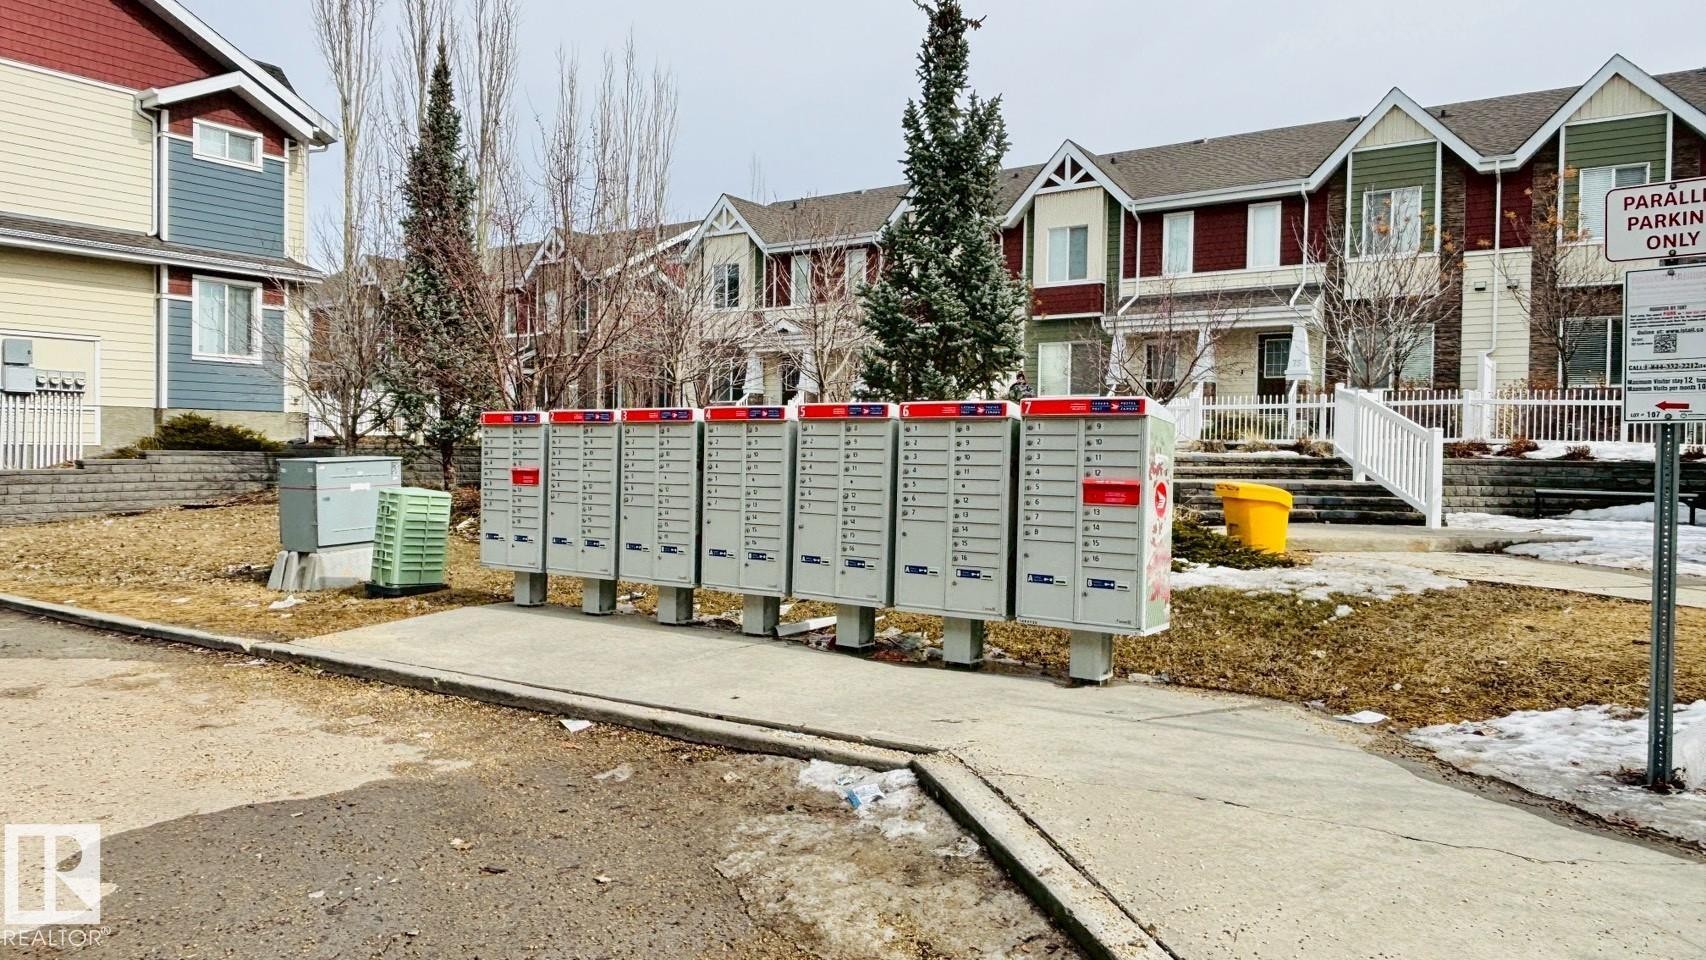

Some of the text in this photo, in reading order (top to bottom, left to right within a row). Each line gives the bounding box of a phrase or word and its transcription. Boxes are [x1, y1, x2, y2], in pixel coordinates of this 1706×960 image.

[1647, 231, 1700, 249] ONLY
[800, 407, 805, 416] 5
[903, 406, 909, 416] 6
[1025, 402, 1031, 413] 7
[623, 411, 627, 420] 3
[706, 409, 711, 419] 4
